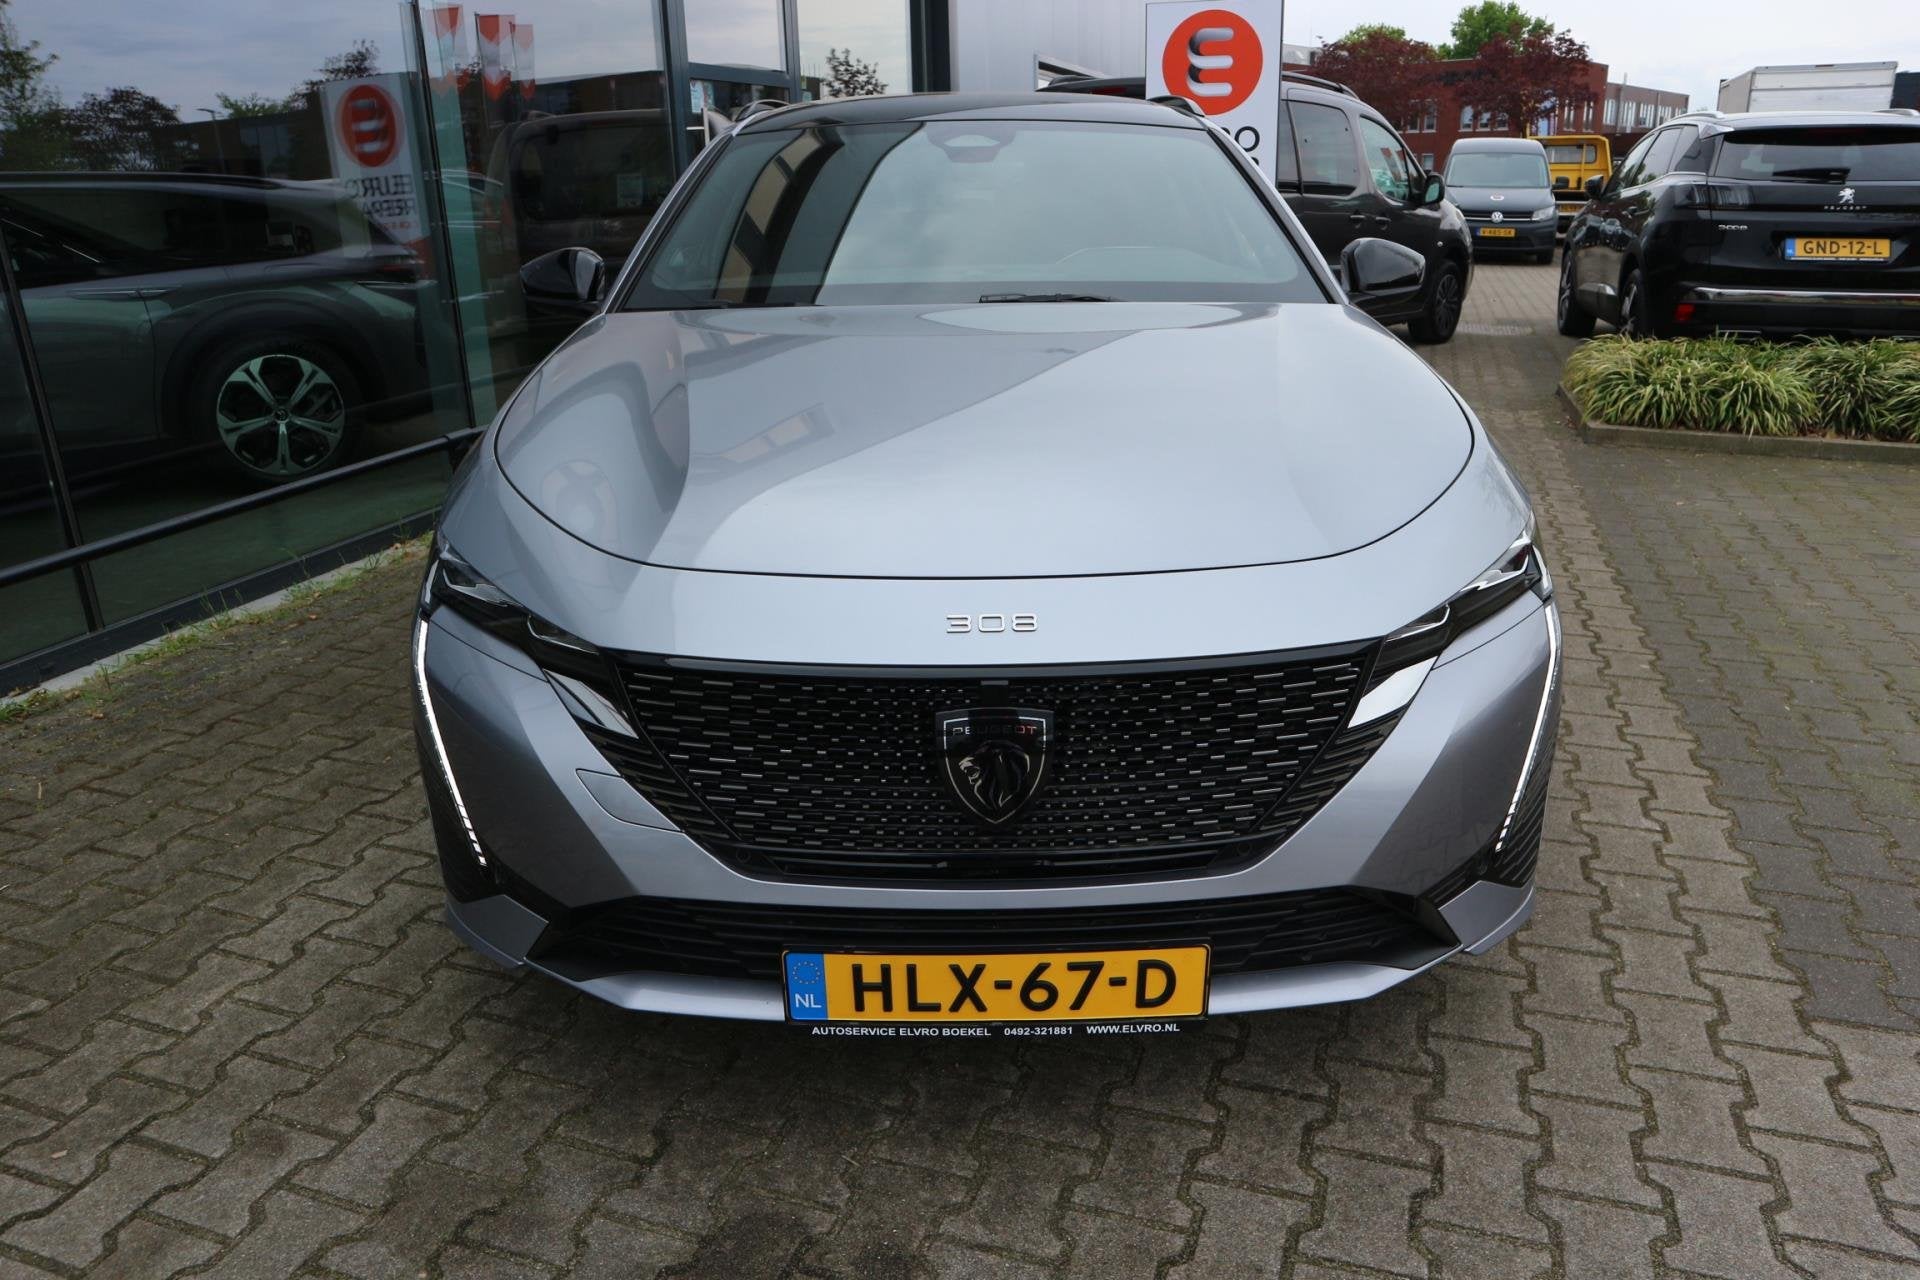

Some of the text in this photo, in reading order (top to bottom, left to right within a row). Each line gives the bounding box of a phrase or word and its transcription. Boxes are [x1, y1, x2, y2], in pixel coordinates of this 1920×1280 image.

[1803, 240, 1883, 255] GND-12-L
[946, 613, 1038, 633] 308
[794, 958, 1177, 1013] NL HLX-67-D
[811, 1023, 1180, 1037] AUTOSERVICE ELVRO BOEKEL 0492-321881 WWW.ELVRO.NL
